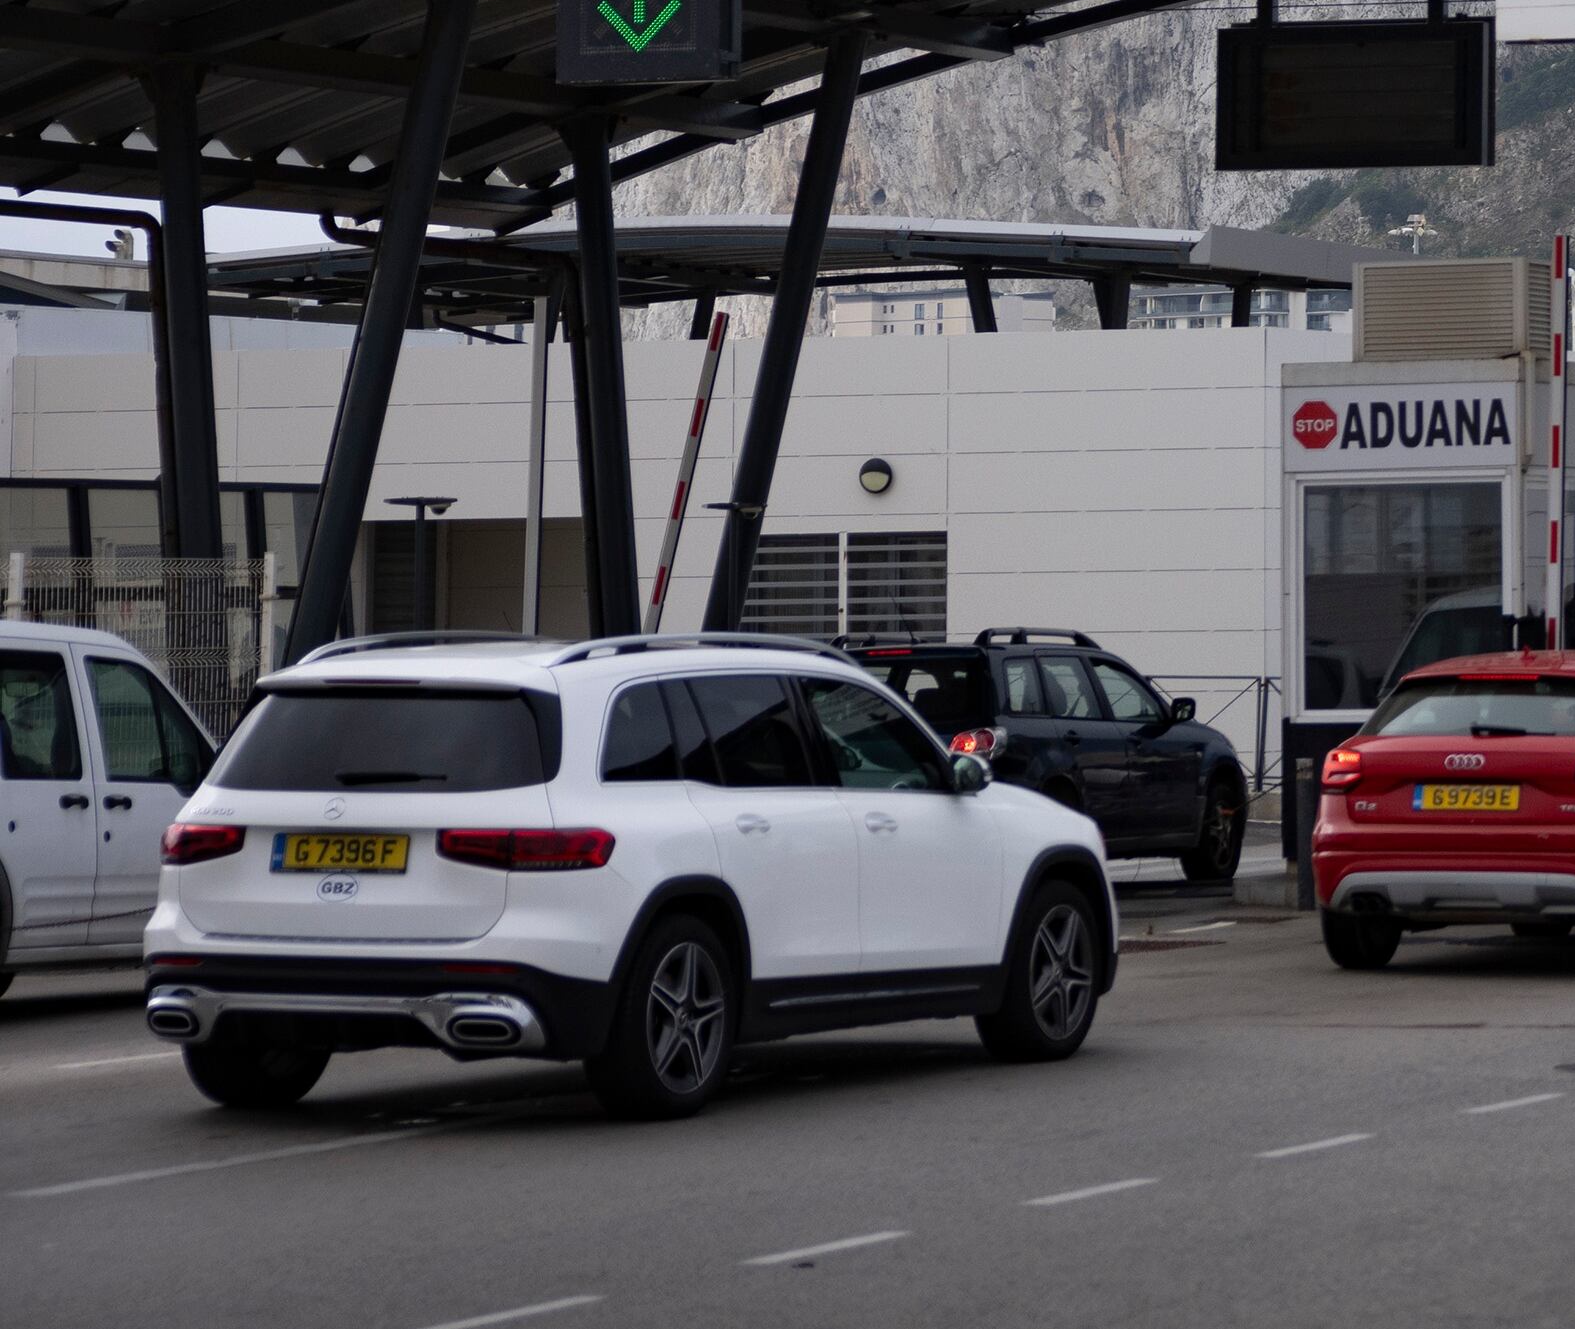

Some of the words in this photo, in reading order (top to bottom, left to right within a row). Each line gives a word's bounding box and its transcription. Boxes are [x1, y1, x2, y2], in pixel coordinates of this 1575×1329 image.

[1295, 418, 1335, 433] STOP
[1339, 398, 1512, 449] ADUANA
[1447, 788, 1496, 806] 9739
[1500, 788, 1511, 806] E
[294, 839, 310, 863] G
[315, 839, 376, 864] 7396
[380, 839, 397, 863] F
[320, 880, 355, 895] GBZ
